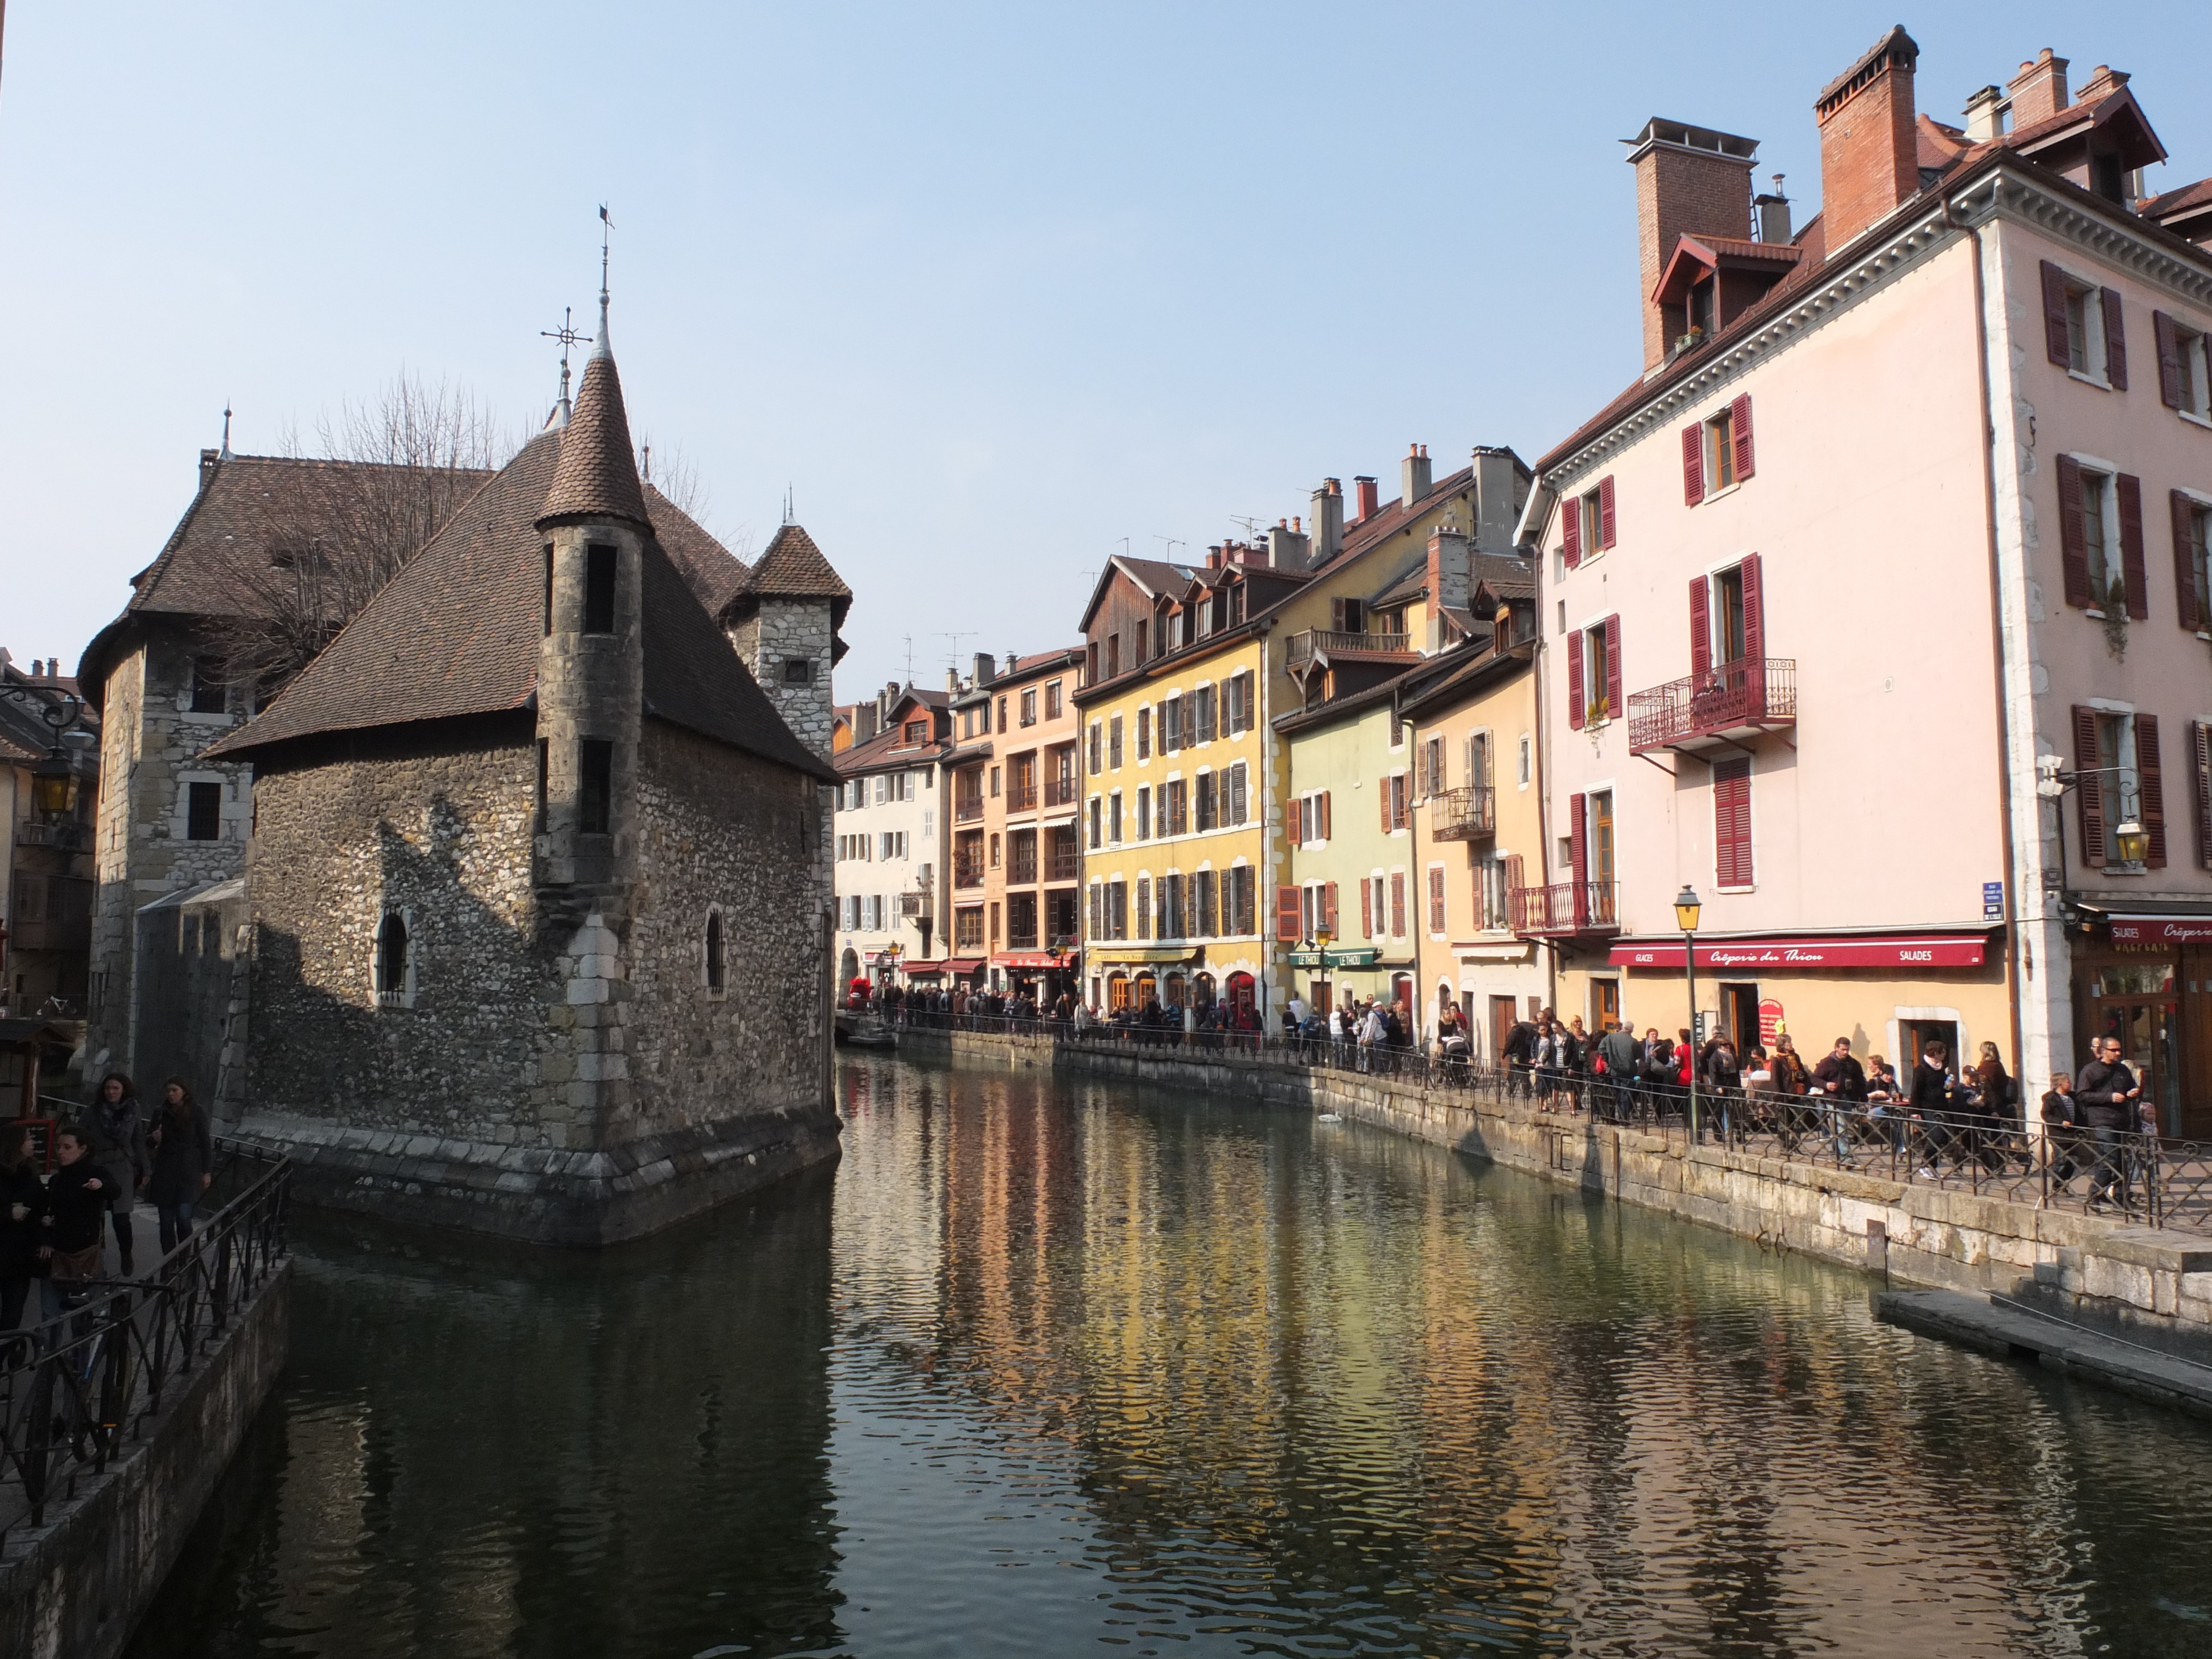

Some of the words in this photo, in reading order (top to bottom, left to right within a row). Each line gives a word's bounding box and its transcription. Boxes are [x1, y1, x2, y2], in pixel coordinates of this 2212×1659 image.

[2112, 927, 2139, 938] SALADES
[1298, 956, 1304, 964] LE
[1635, 953, 1653, 962] GLACES
[1710, 951, 1757, 966] Crêperie
[1760, 951, 1780, 961] du
[1783, 949, 1824, 961] Thiou
[1900, 950, 1932, 961] SALADES
[1339, 956, 1345, 966] LE
